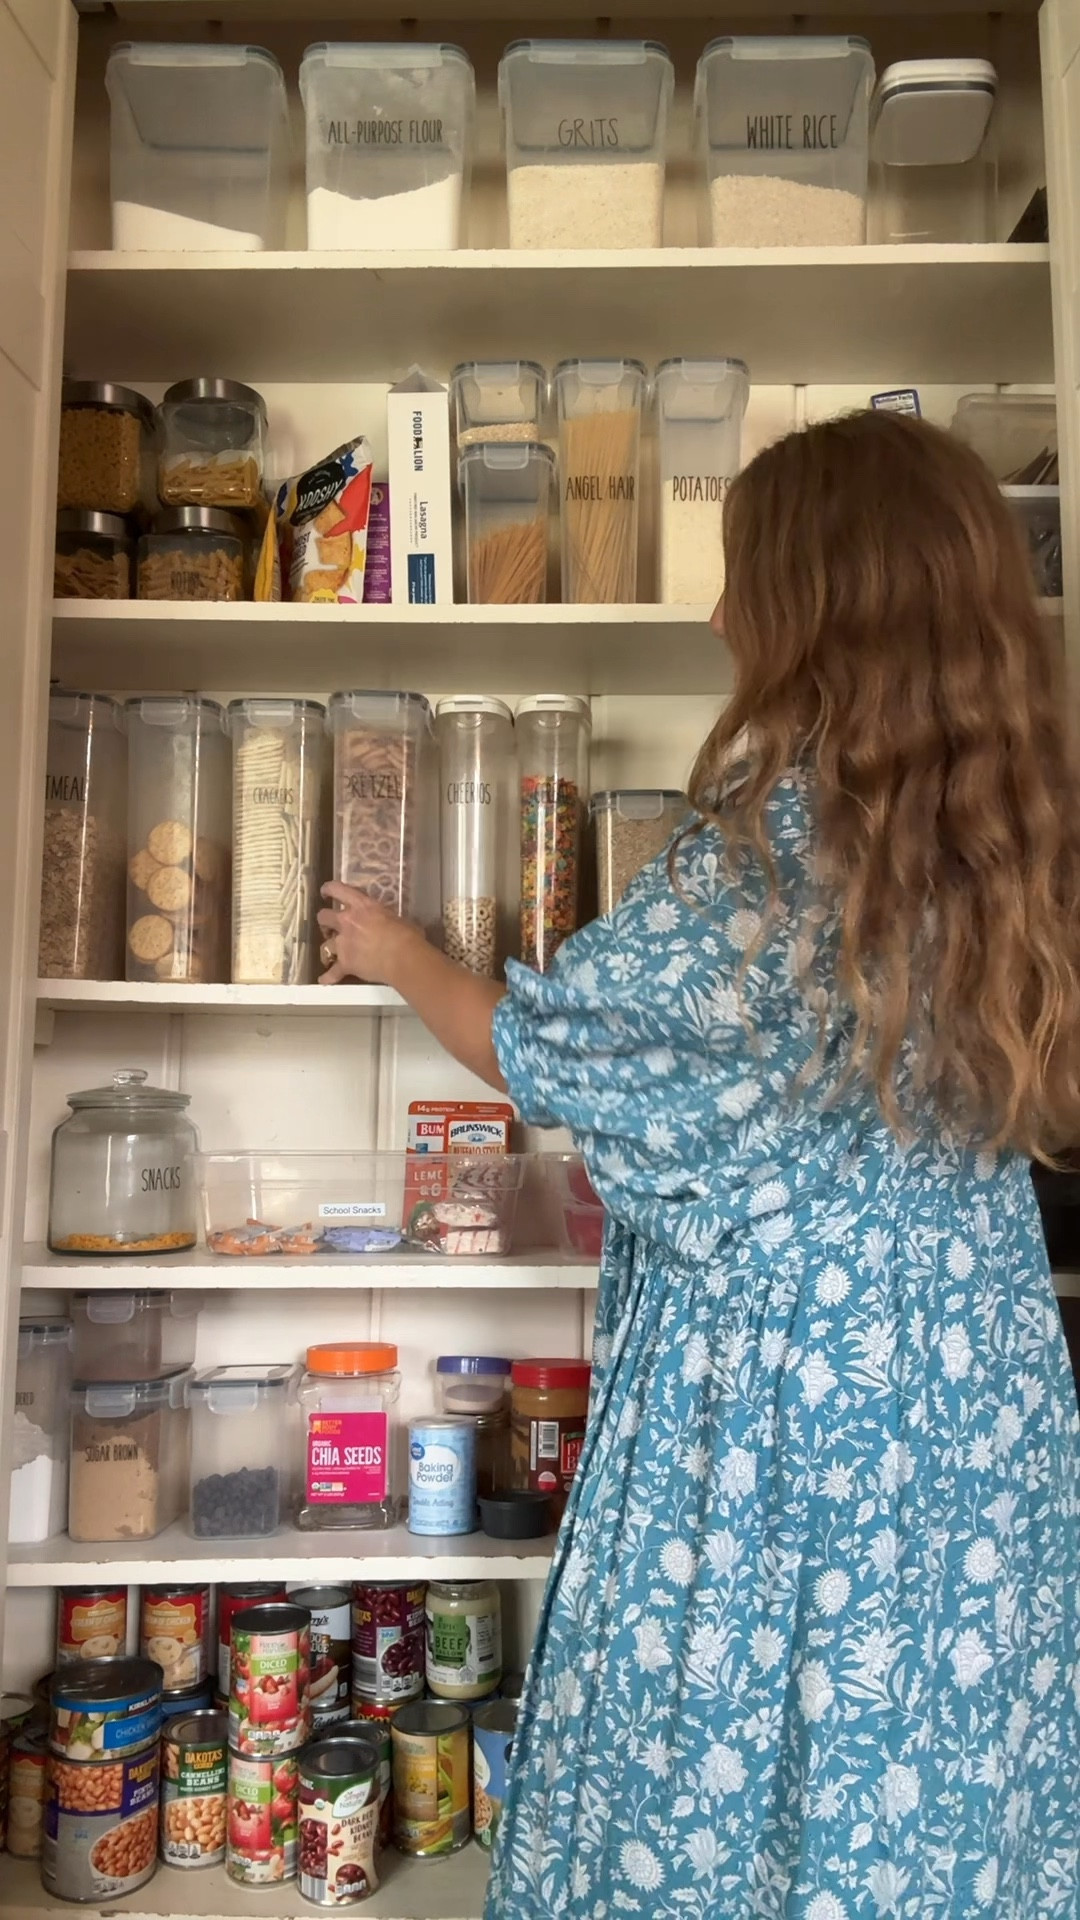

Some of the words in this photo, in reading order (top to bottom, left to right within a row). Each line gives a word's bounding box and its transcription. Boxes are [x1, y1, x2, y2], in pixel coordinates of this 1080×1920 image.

[328, 119, 403, 144] ALL-PURPOSE
[409, 119, 443, 144] FLOUR
[558, 117, 619, 147] GRITS
[747, 114, 793, 150] WHITE
[802, 114, 838, 149] RICE
[412, 410, 422, 437] FOOD
[412, 448, 424, 472] LION
[565, 475, 603, 501] ANGEL
[609, 475, 636, 501] HAIR
[419, 501, 429, 540] Lasagna
[252, 786, 295, 805] CRACKERS
[447, 782, 492, 805] CHEERIOS
[450, 1123, 502, 1138] BRUNSWICK
[141, 1166, 181, 1192] SNACKS
[322, 1206, 351, 1216] School
[352, 1205, 382, 1216] Snacks
[113, 1444, 139, 1461] BROWN
[311, 1447, 340, 1466] CHIA
[344, 1446, 382, 1465] SEEDS
[416, 1471, 454, 1483] Powder
[418, 1462, 454, 1474] Baking
[435, 1636, 464, 1650] BEEF
[259, 1659, 287, 1668] DICED
[186, 1776, 220, 1787] BEANS
[341, 1816, 360, 1828] DARK
[349, 1820, 374, 1836] KIDNEY
